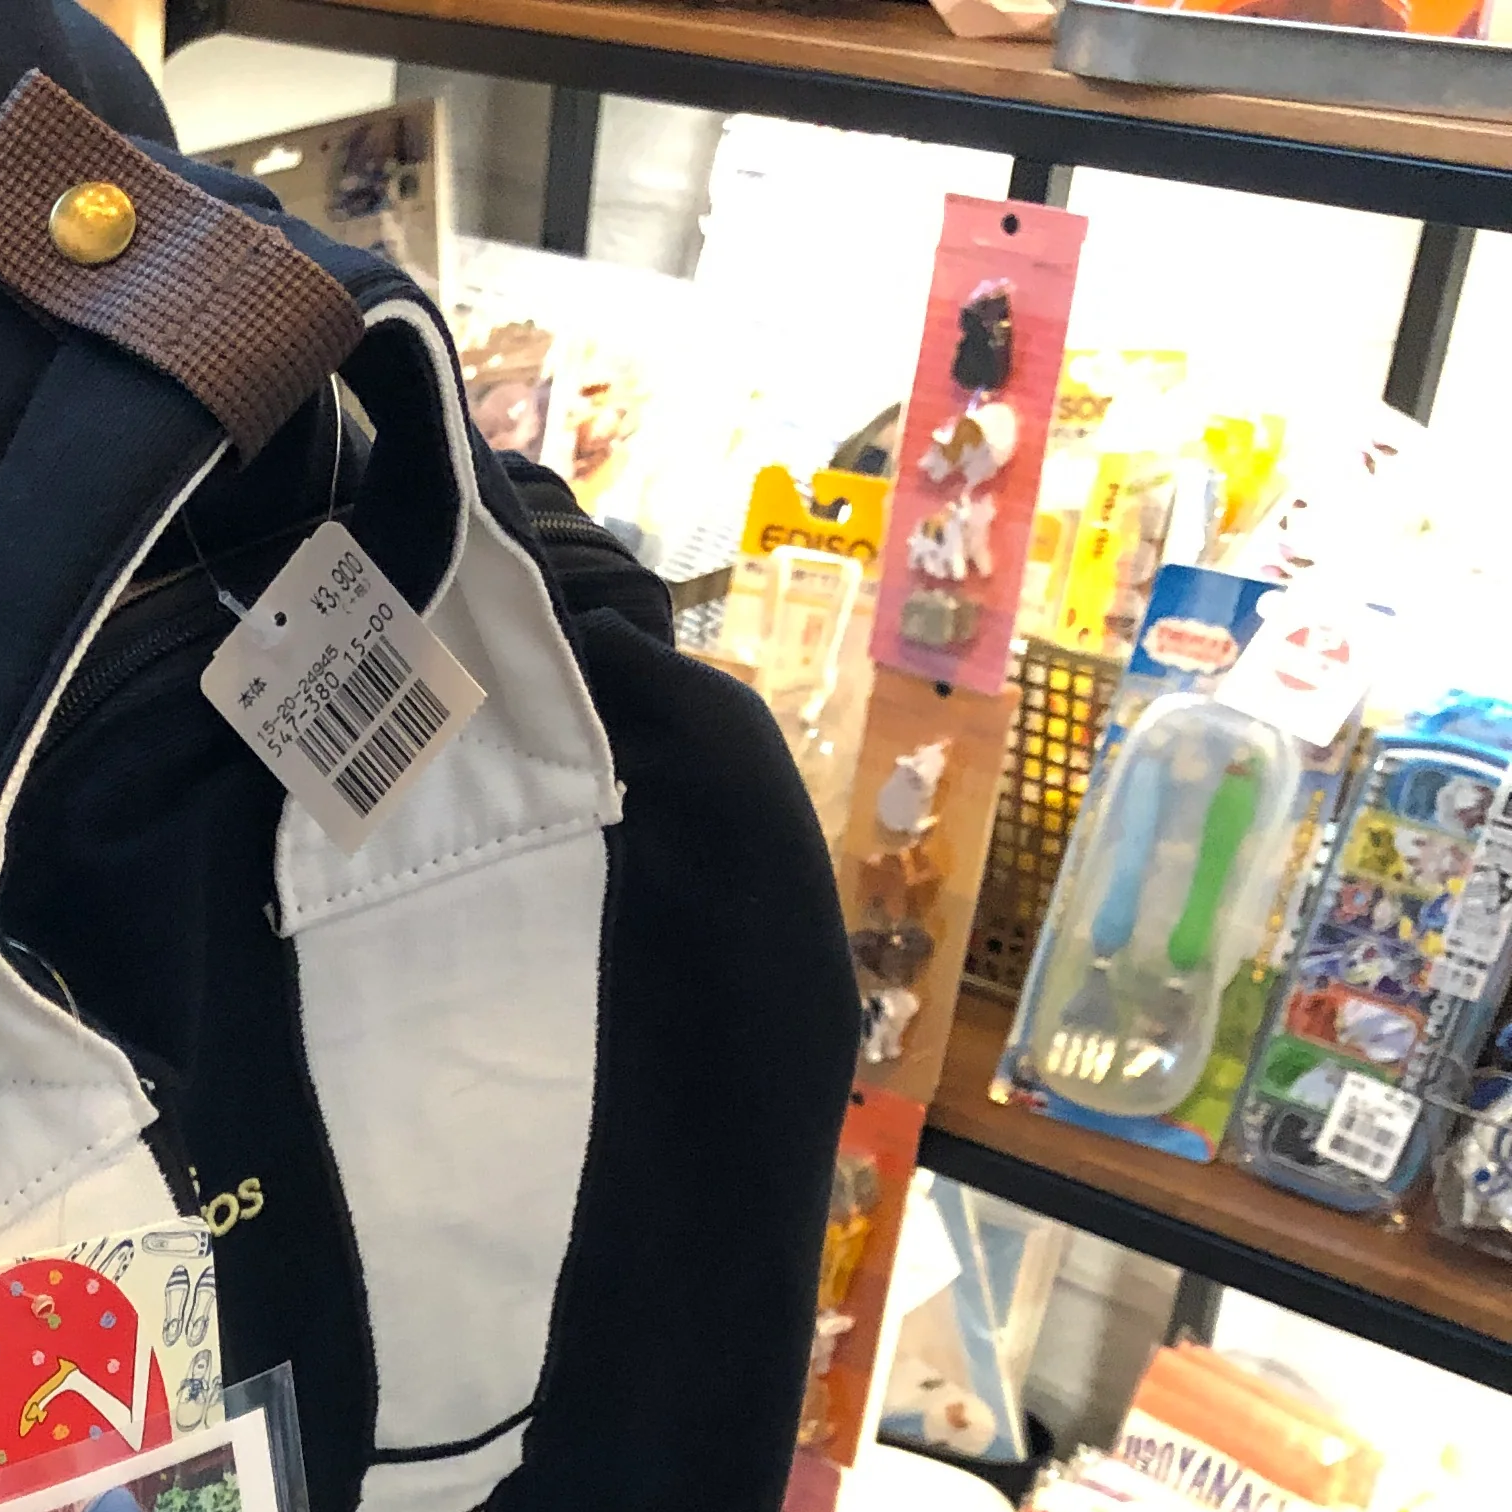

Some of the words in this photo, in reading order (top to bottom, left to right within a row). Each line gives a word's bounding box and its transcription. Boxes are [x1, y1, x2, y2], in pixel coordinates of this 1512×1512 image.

[310, 551, 364, 614] ¥3,900
[238, 676, 267, 709] 本体
[268, 671, 340, 757] 547-380
[343, 602, 394, 665] 15-00
